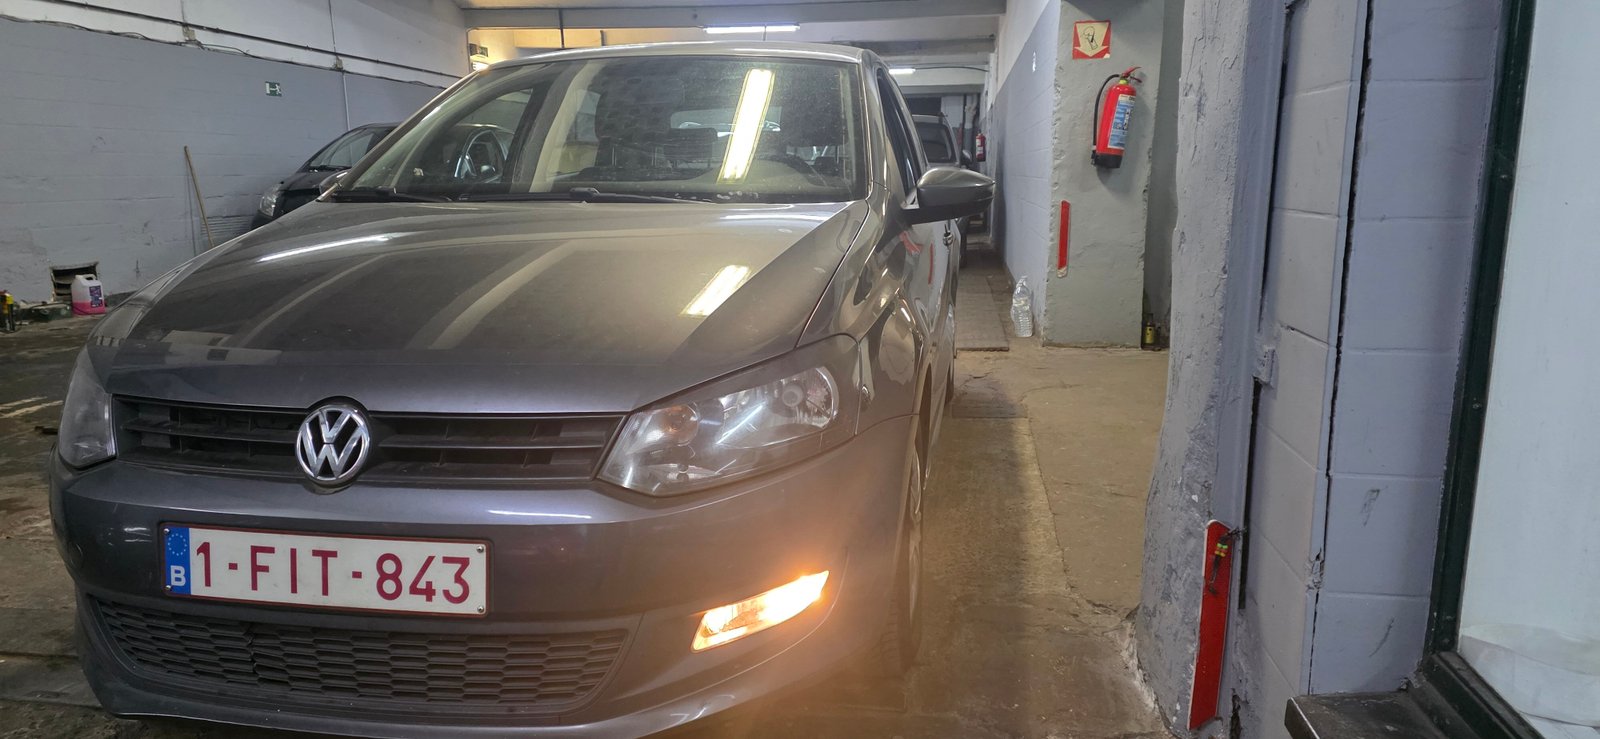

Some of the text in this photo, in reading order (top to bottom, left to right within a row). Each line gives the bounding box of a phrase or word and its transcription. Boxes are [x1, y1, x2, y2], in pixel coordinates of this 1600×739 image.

[298, 406, 368, 482] VW
[170, 565, 187, 587] B
[196, 541, 471, 604] 1-FIT-843
